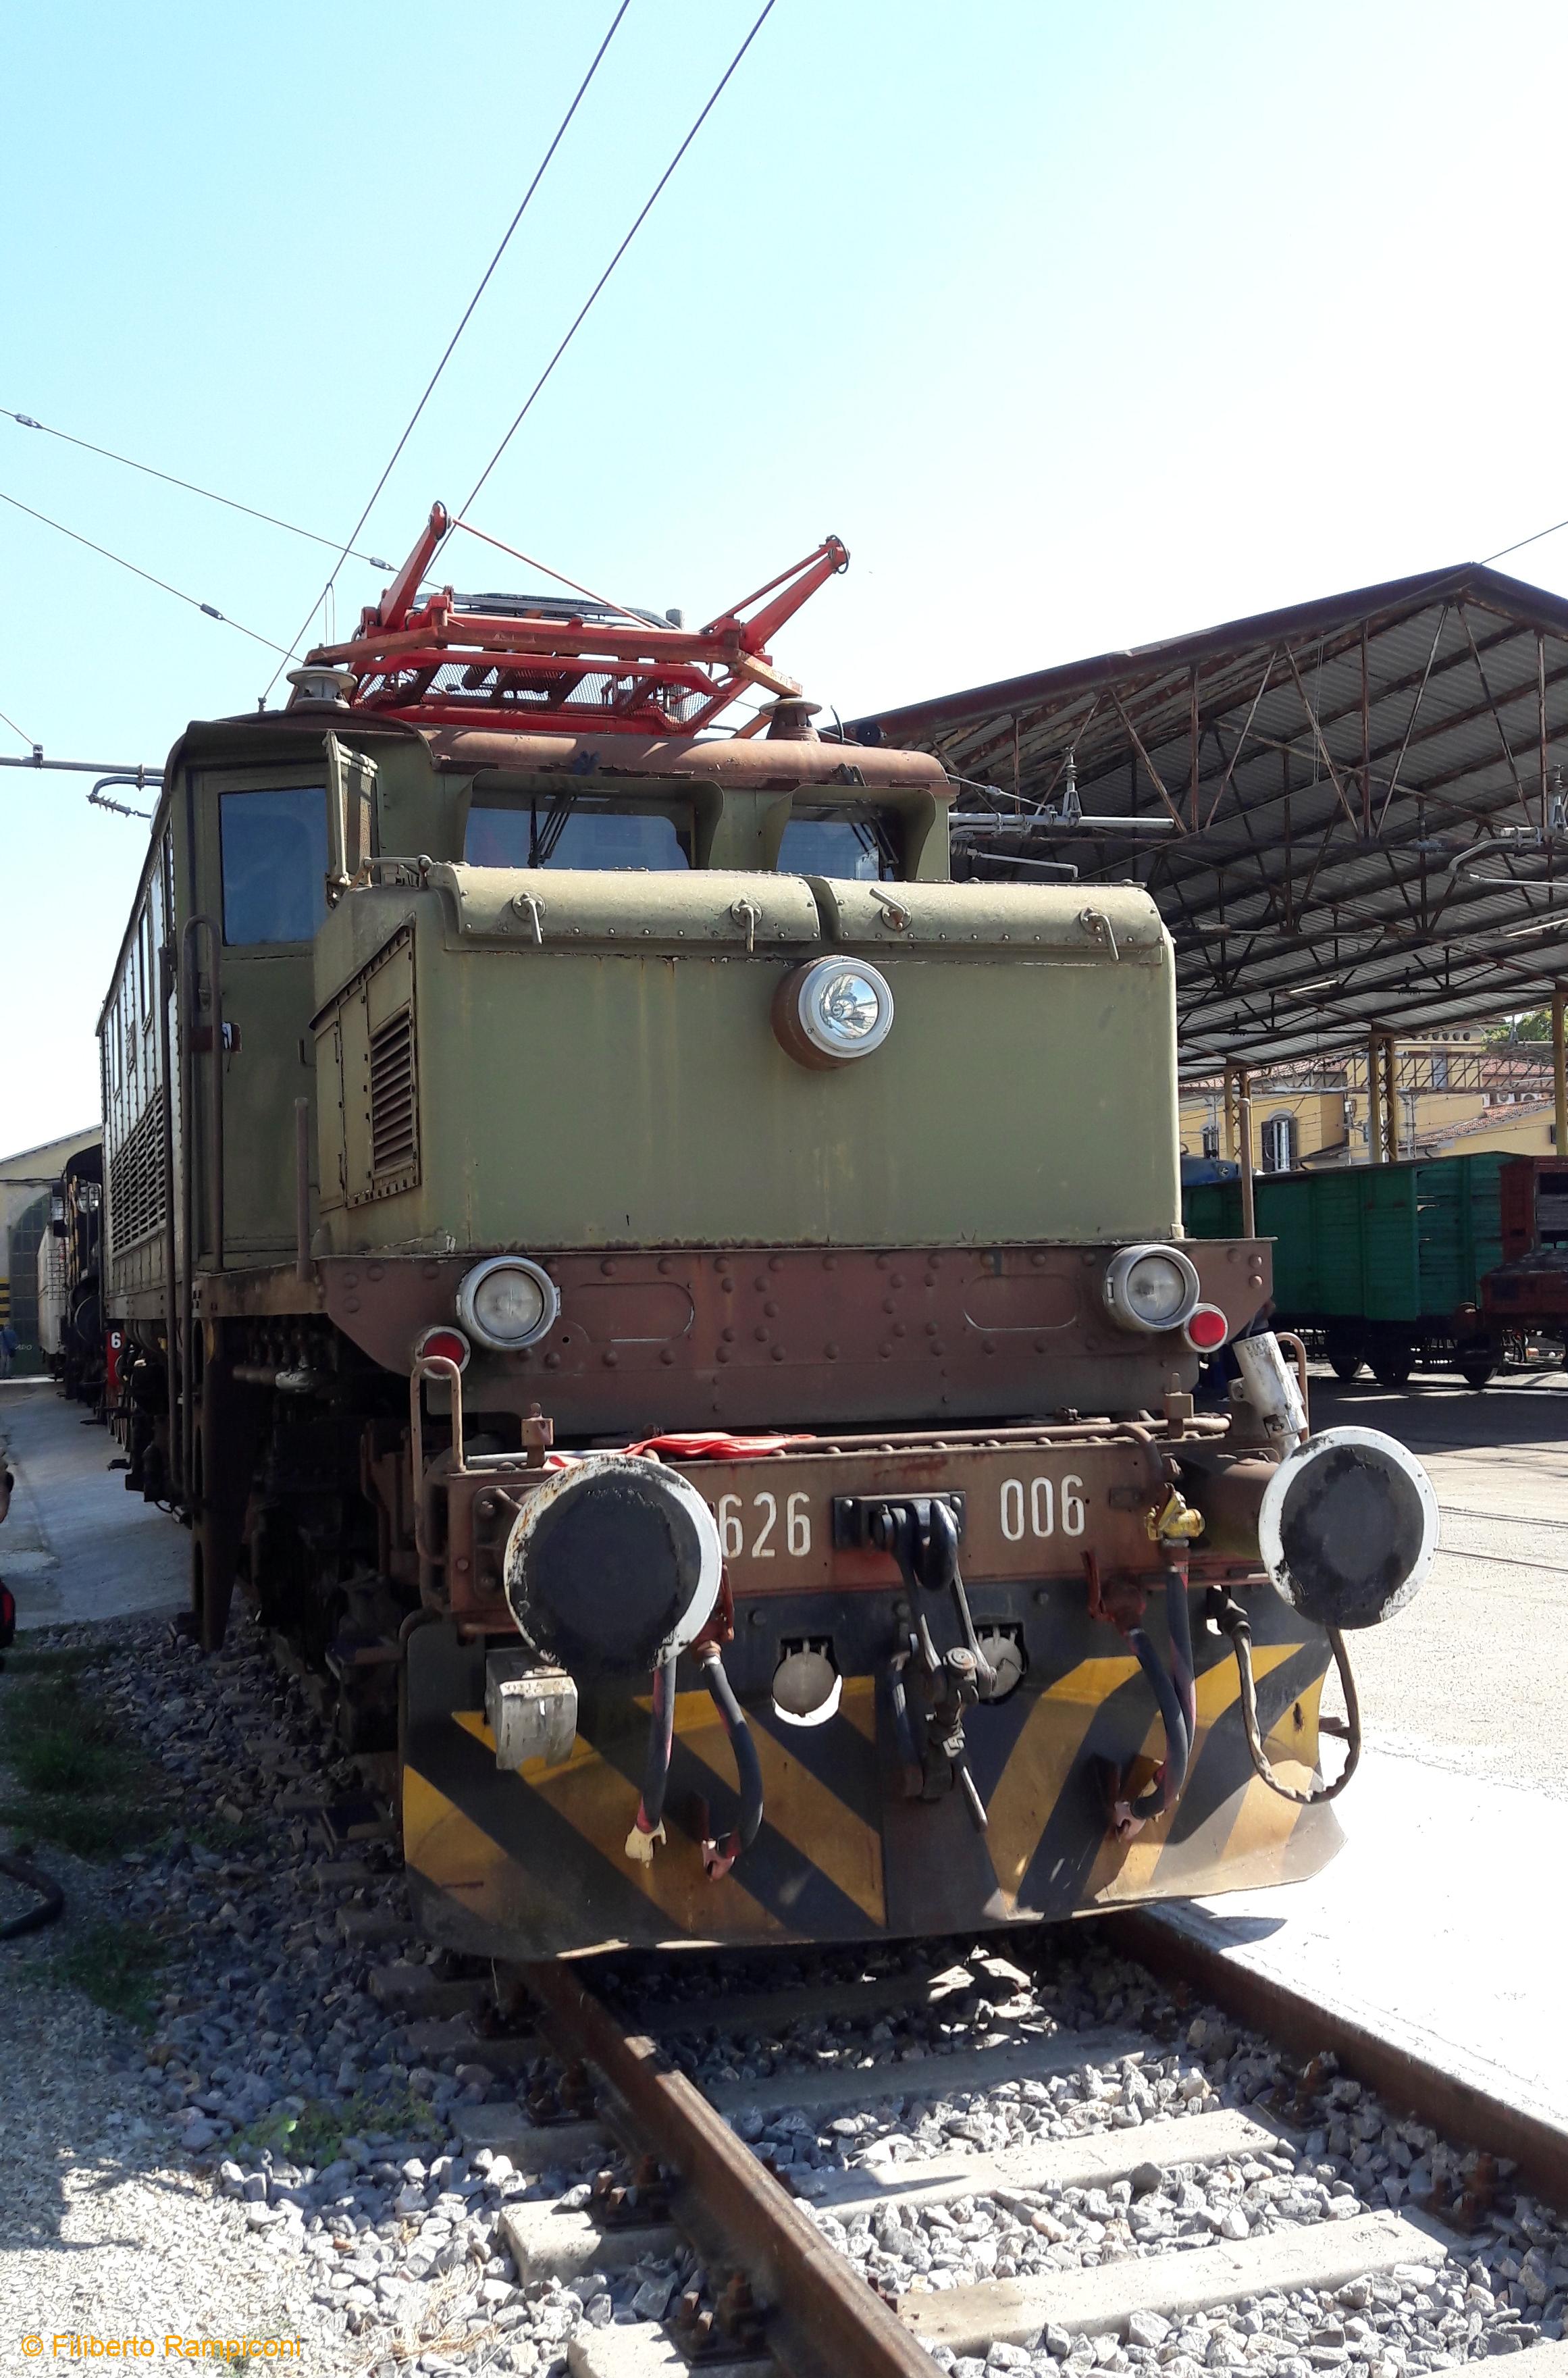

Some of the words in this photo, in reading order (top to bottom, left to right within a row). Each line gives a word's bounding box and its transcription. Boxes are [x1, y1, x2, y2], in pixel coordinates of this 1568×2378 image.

[111, 1332, 122, 1349] 6
[718, 1491, 811, 1558] 626
[1000, 1474, 1085, 1541] 006
